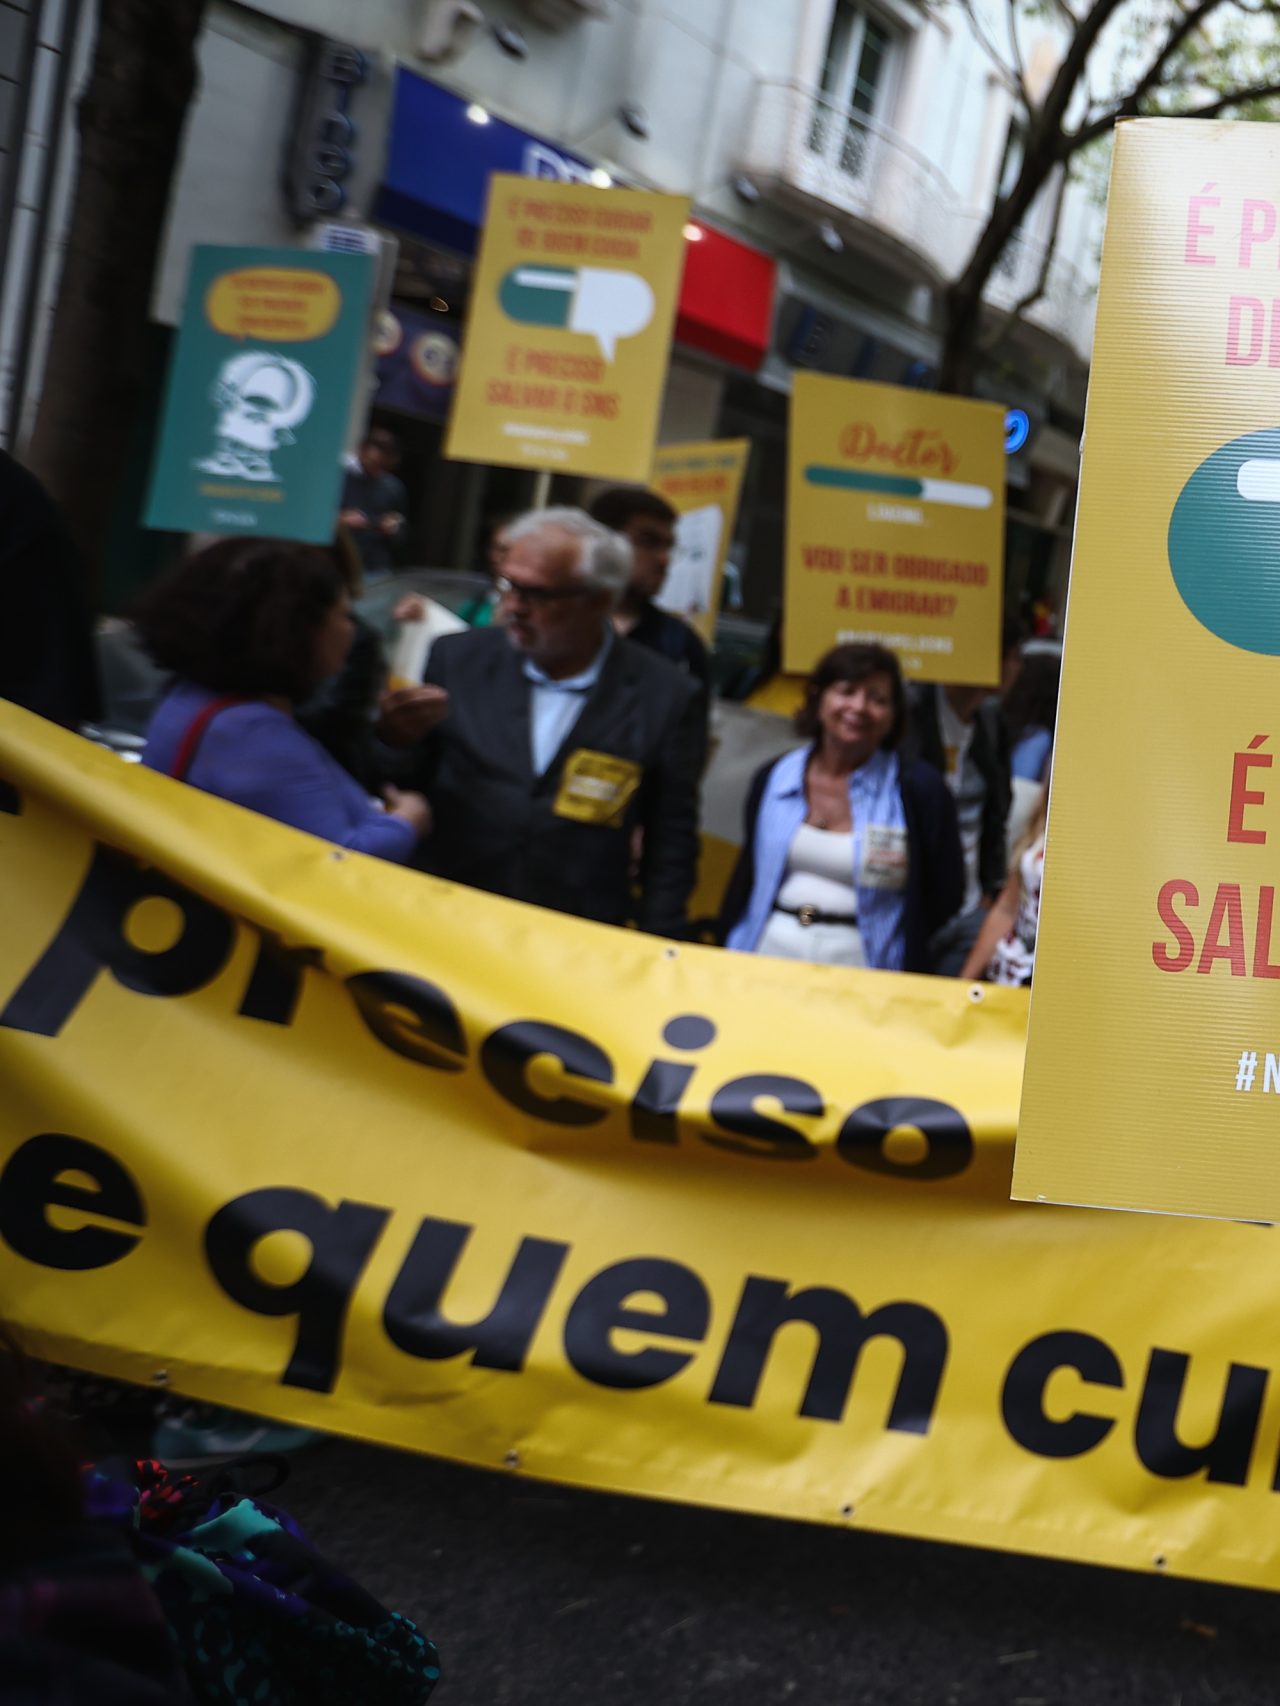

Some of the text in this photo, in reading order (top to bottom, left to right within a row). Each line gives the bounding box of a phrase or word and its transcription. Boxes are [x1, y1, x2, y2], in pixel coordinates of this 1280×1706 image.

[1184, 182, 1221, 266] É
[1227, 734, 1274, 845] É
[0, 838, 975, 1180] preciso
[204, 1186, 950, 1437] quem
